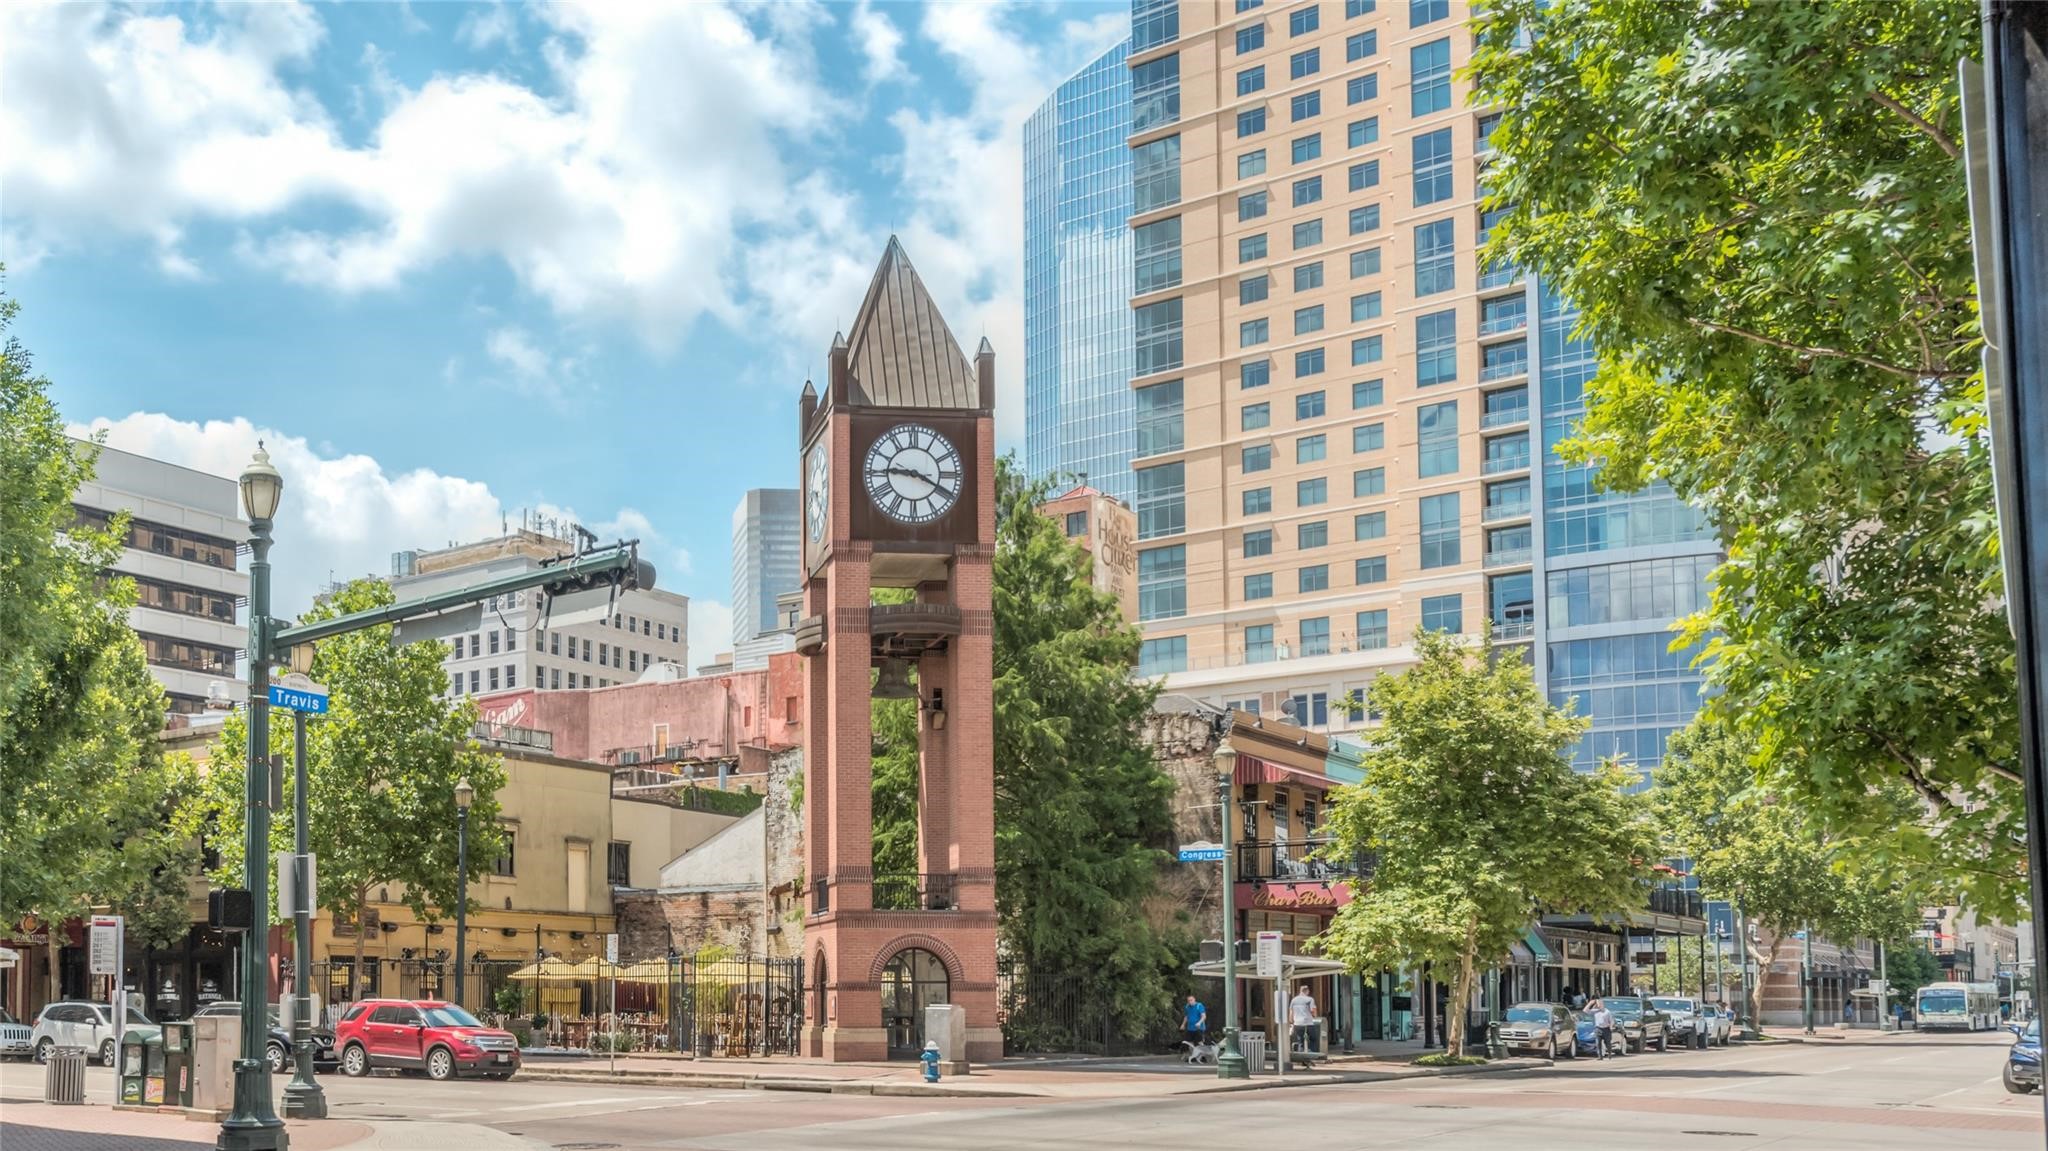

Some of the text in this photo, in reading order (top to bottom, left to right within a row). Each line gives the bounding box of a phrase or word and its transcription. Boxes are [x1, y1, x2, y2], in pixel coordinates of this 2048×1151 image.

[275, 689, 320, 710] Travis
[1181, 851, 1222, 860] Congress
[1296, 889, 1336, 906] Bar
